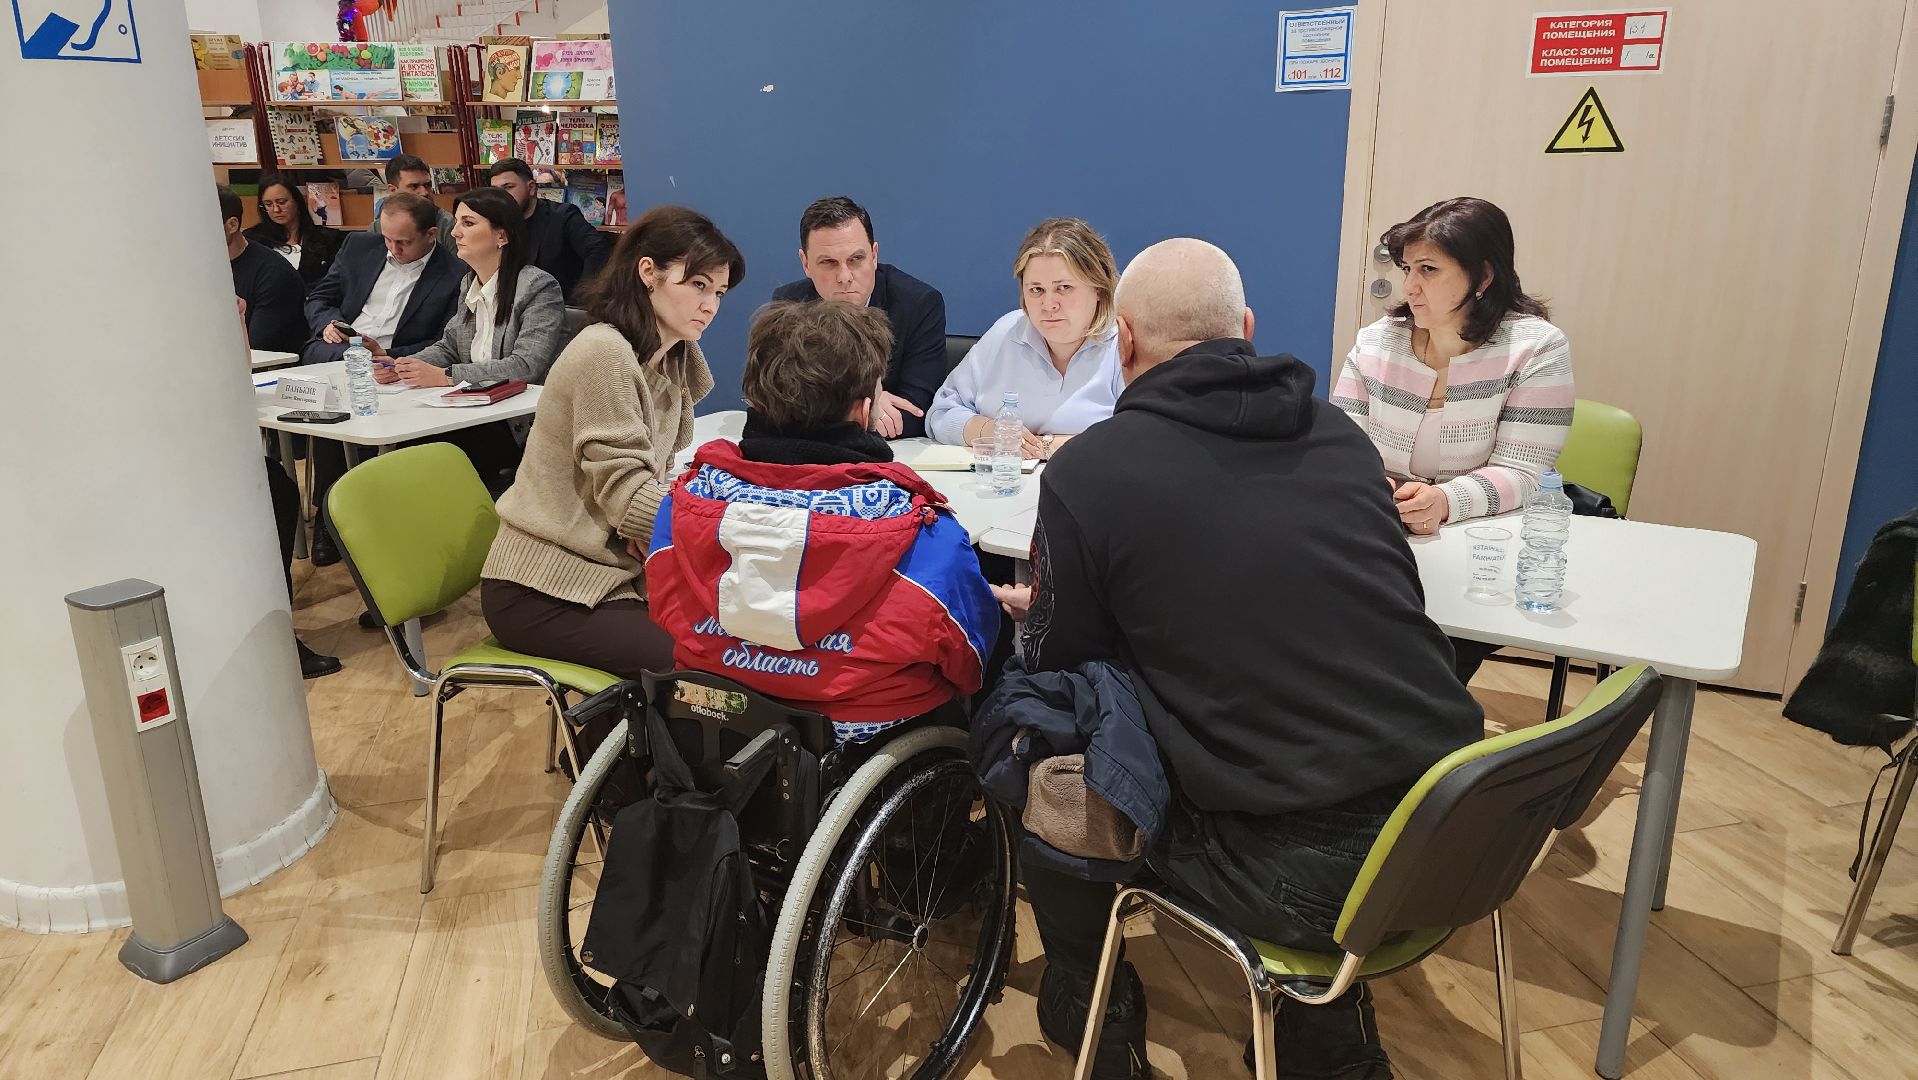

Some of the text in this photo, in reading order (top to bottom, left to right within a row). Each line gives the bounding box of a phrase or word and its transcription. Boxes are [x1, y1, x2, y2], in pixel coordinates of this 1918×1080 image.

[1550, 19, 1613, 29] КАТЕГОРИЯ
[1542, 29, 1616, 40] ПОМЕЩЕНИЯ
[1541, 47, 1614, 57] КЛАСС ЗОНЫ
[1540, 57, 1613, 67] ПОМЕЩЕНИЯ
[1291, 69, 1307, 79] 101
[1323, 67, 1341, 78] 112
[286, 113, 303, 125] 30
[722, 641, 819, 676] область
